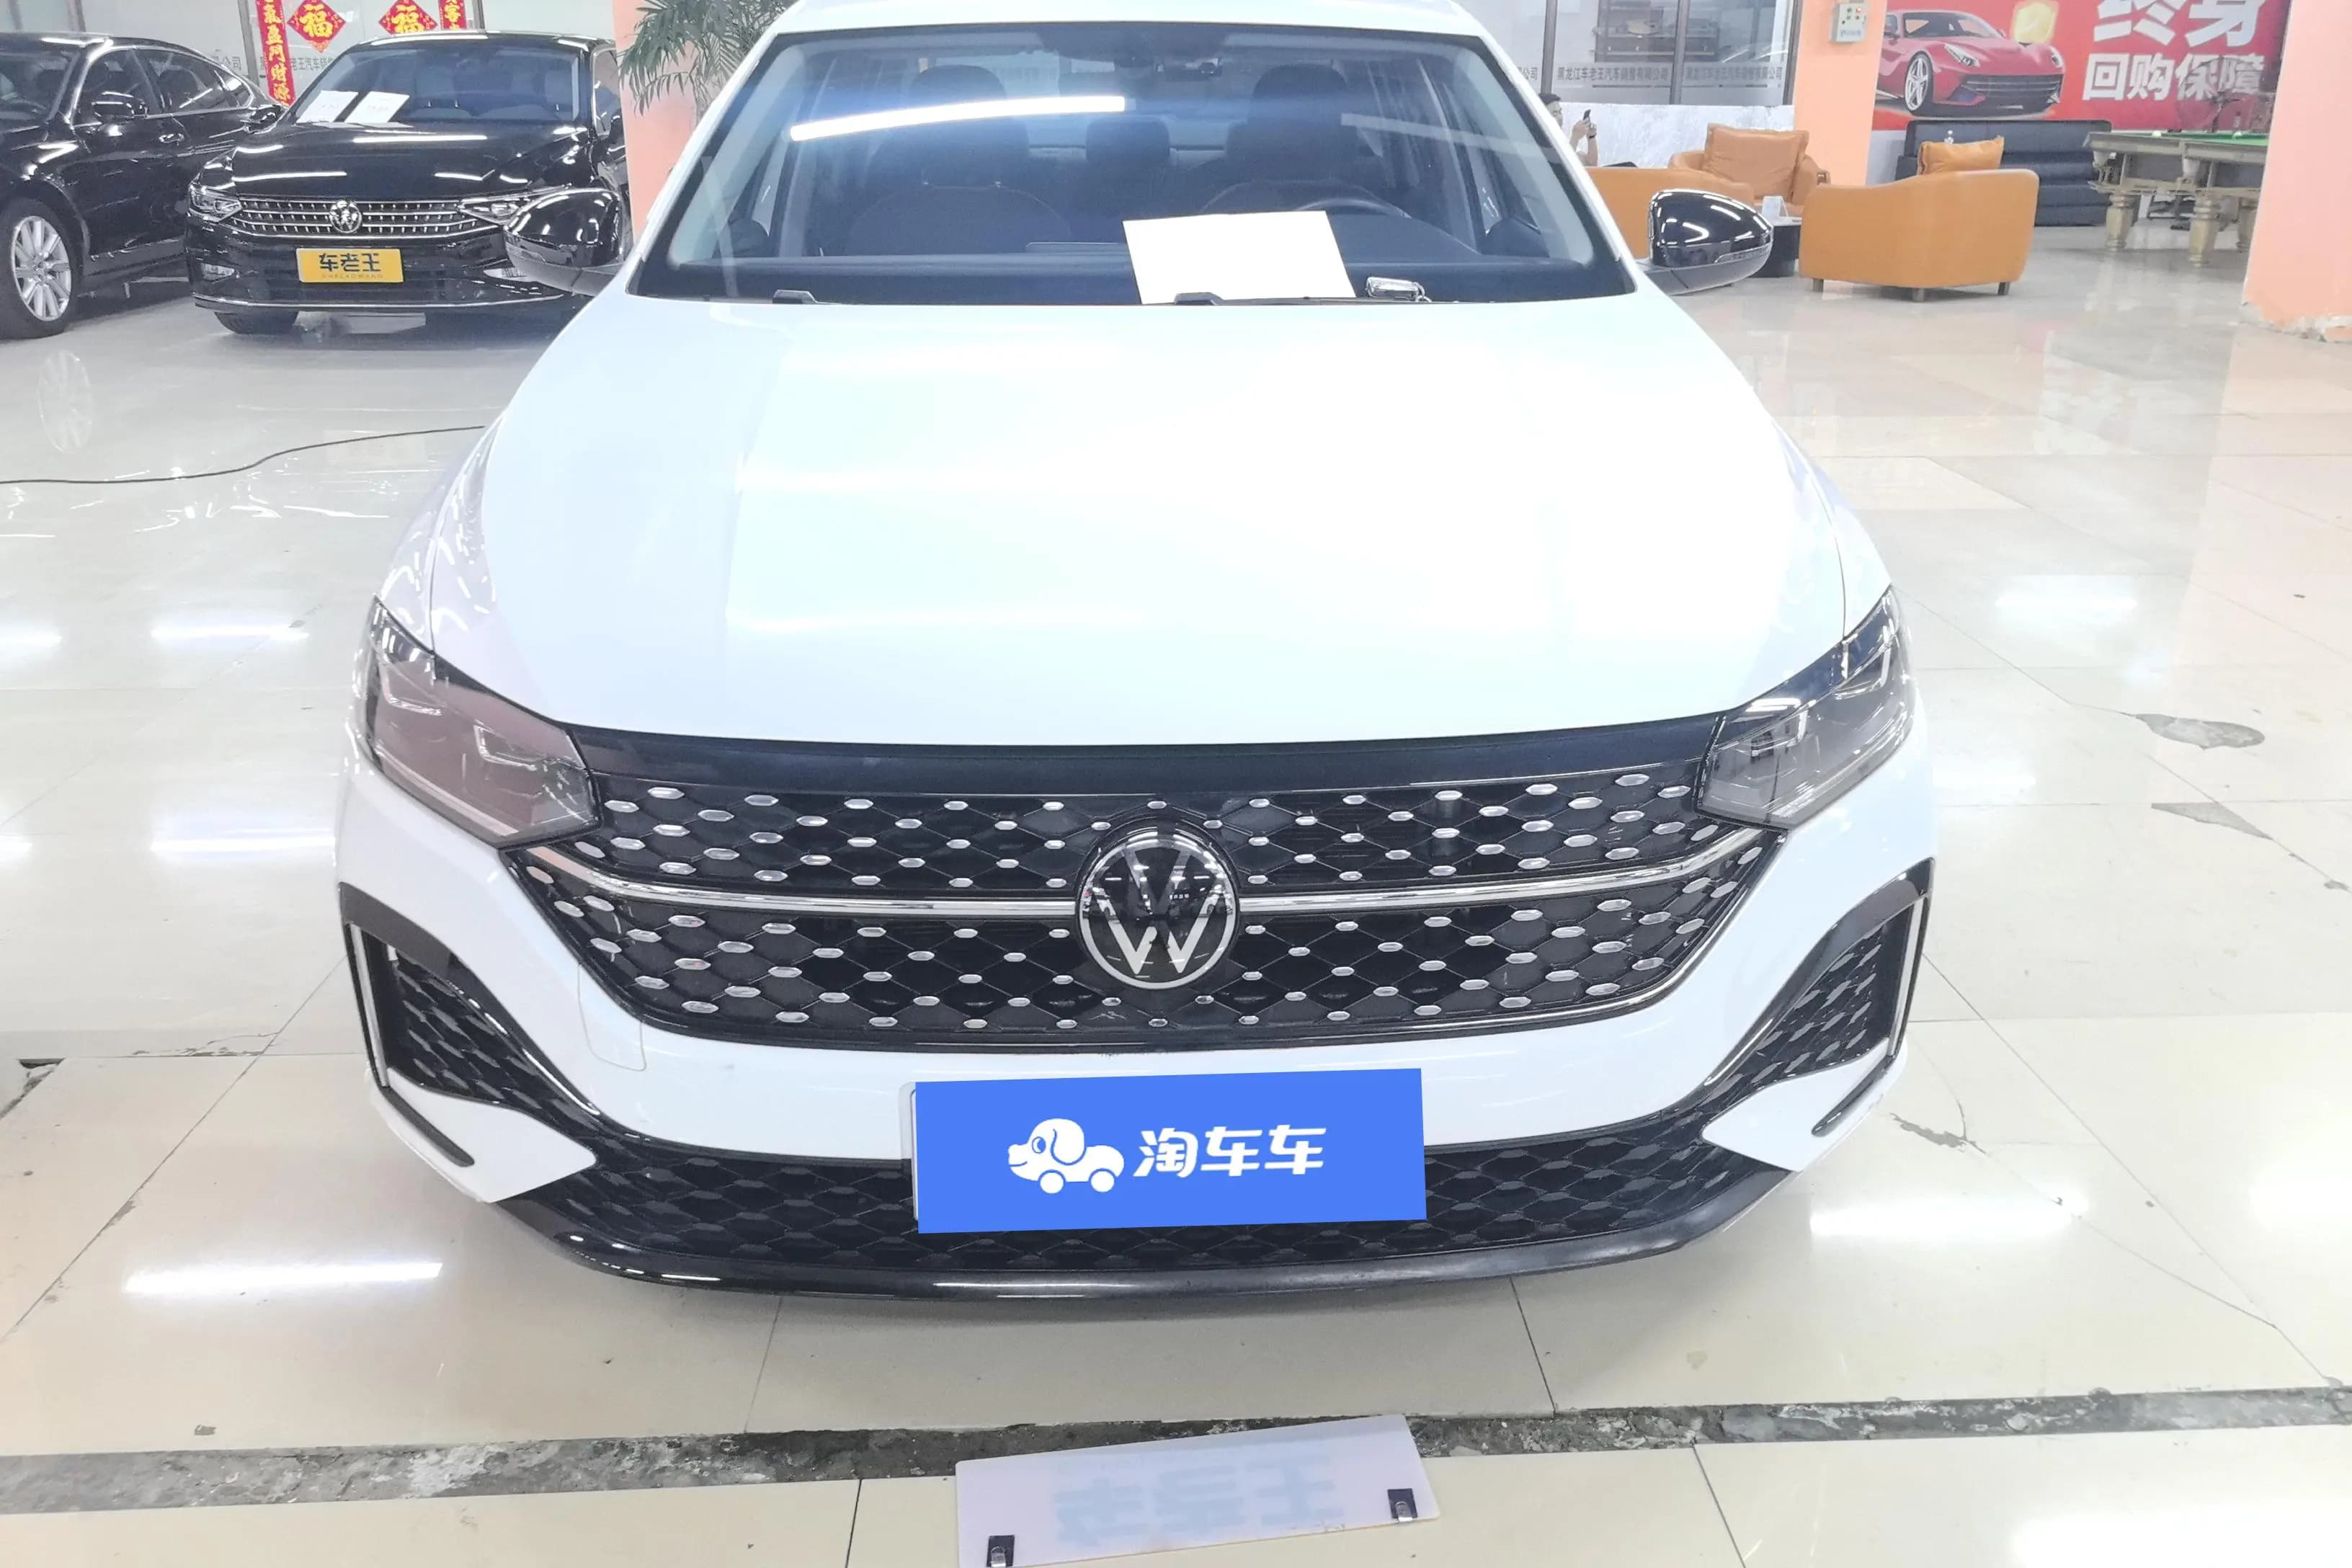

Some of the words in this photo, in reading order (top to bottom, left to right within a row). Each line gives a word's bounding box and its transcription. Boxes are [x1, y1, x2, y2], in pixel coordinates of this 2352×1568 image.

[299, 4, 334, 37] 福
[391, 5, 425, 33] 福
[210, 56, 241, 71] 公司
[1518, 67, 1538, 80] 公司
[2082, 52, 2265, 100] 回购保障
[318, 253, 381, 272] 车老王
